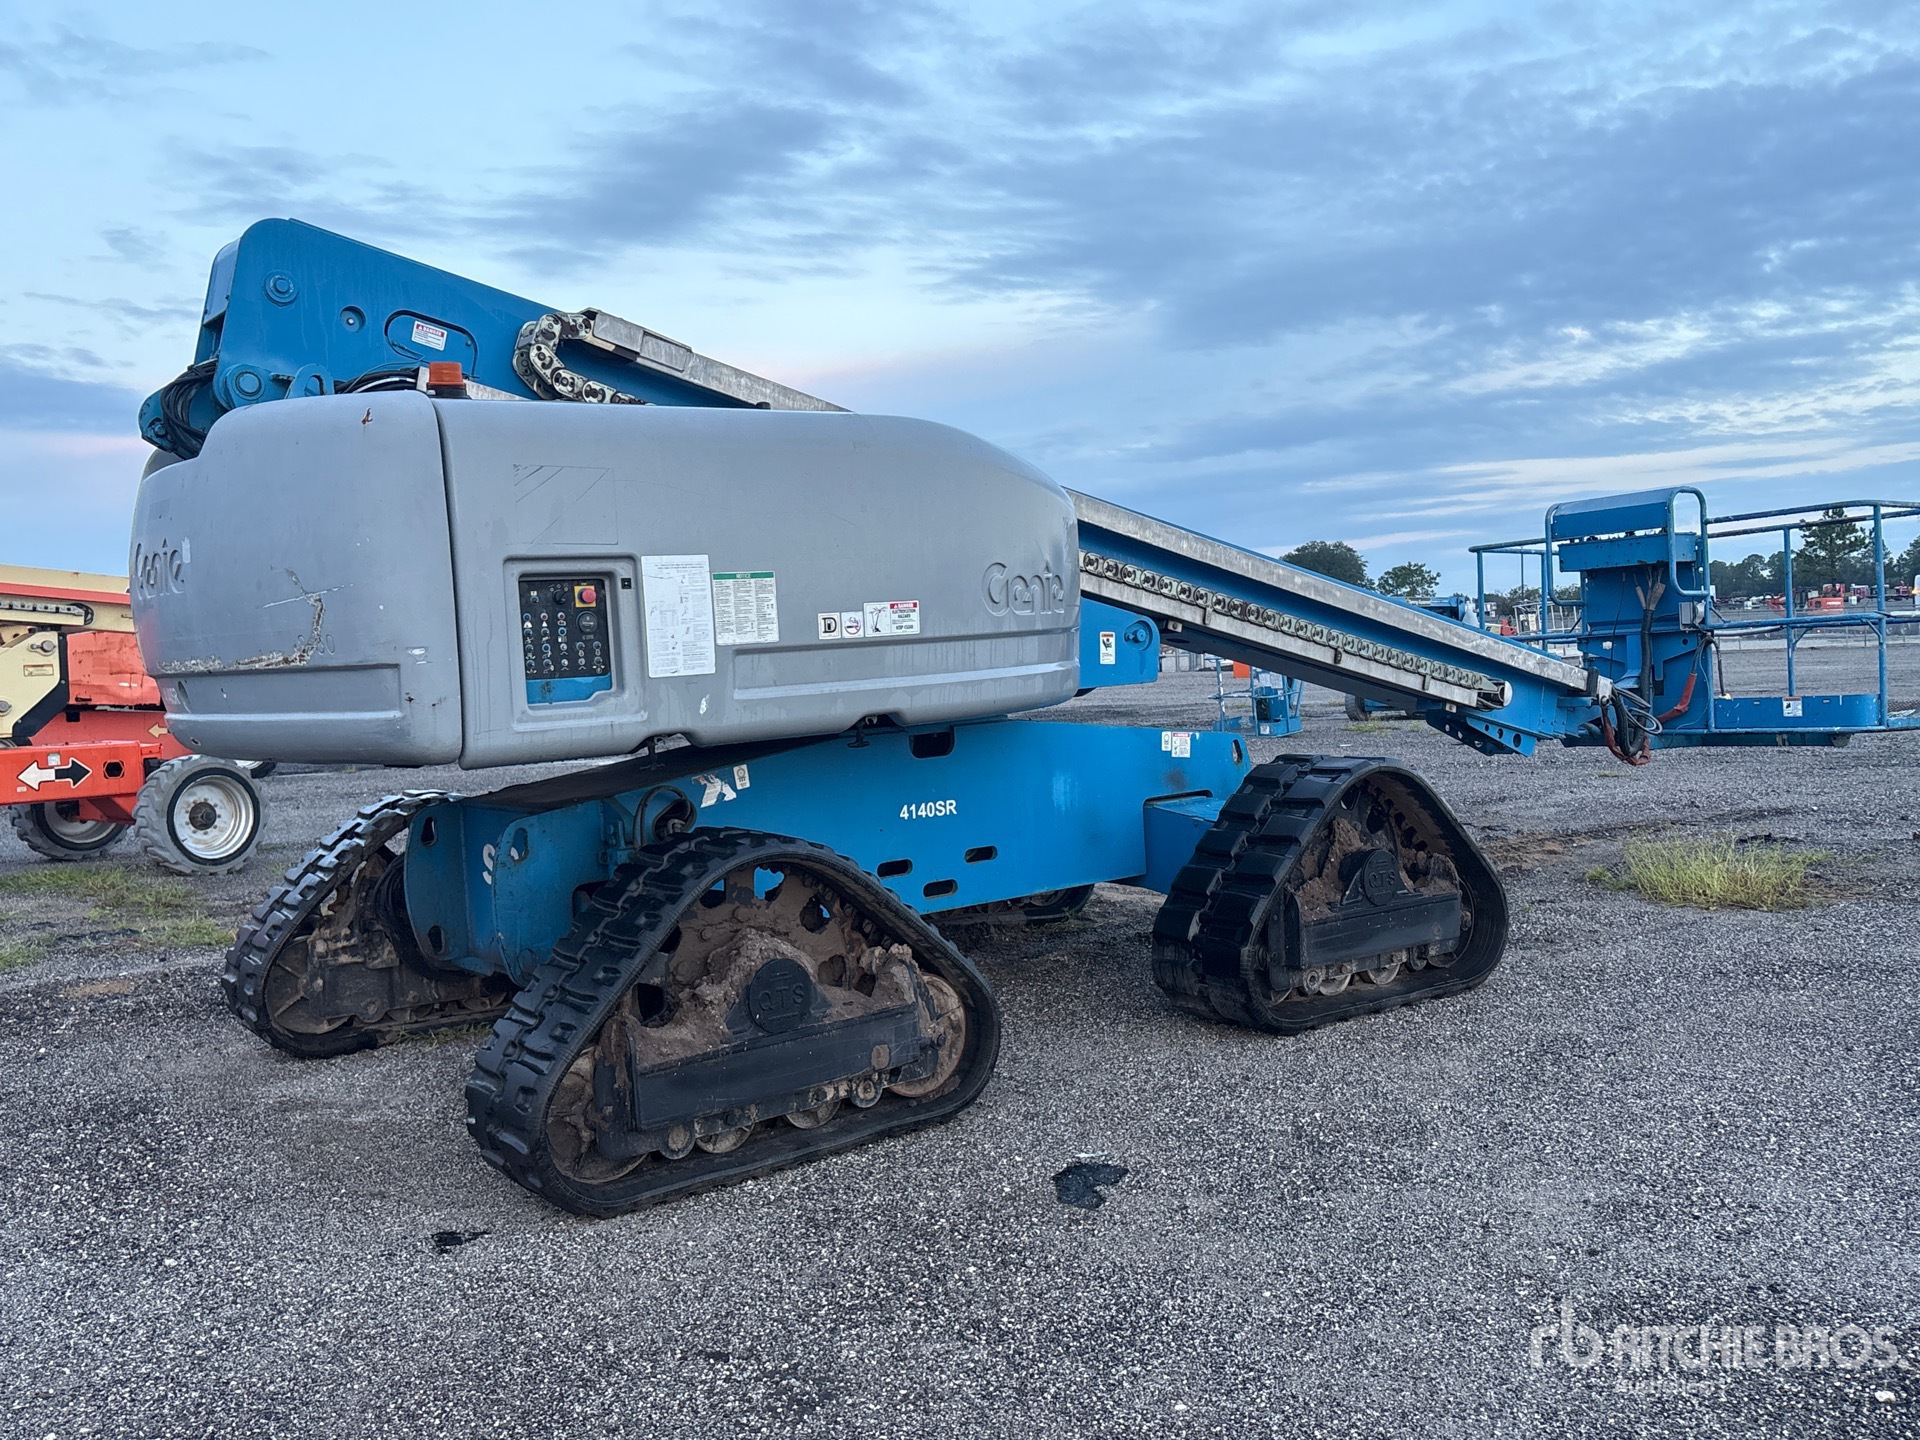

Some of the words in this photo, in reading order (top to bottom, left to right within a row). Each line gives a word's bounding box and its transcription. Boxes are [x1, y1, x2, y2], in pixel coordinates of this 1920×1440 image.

[423, 326, 442, 336] DANGER
[981, 560, 1064, 617] Genie
[900, 799, 957, 820] 4140SR
[759, 983, 805, 1011] QTS
